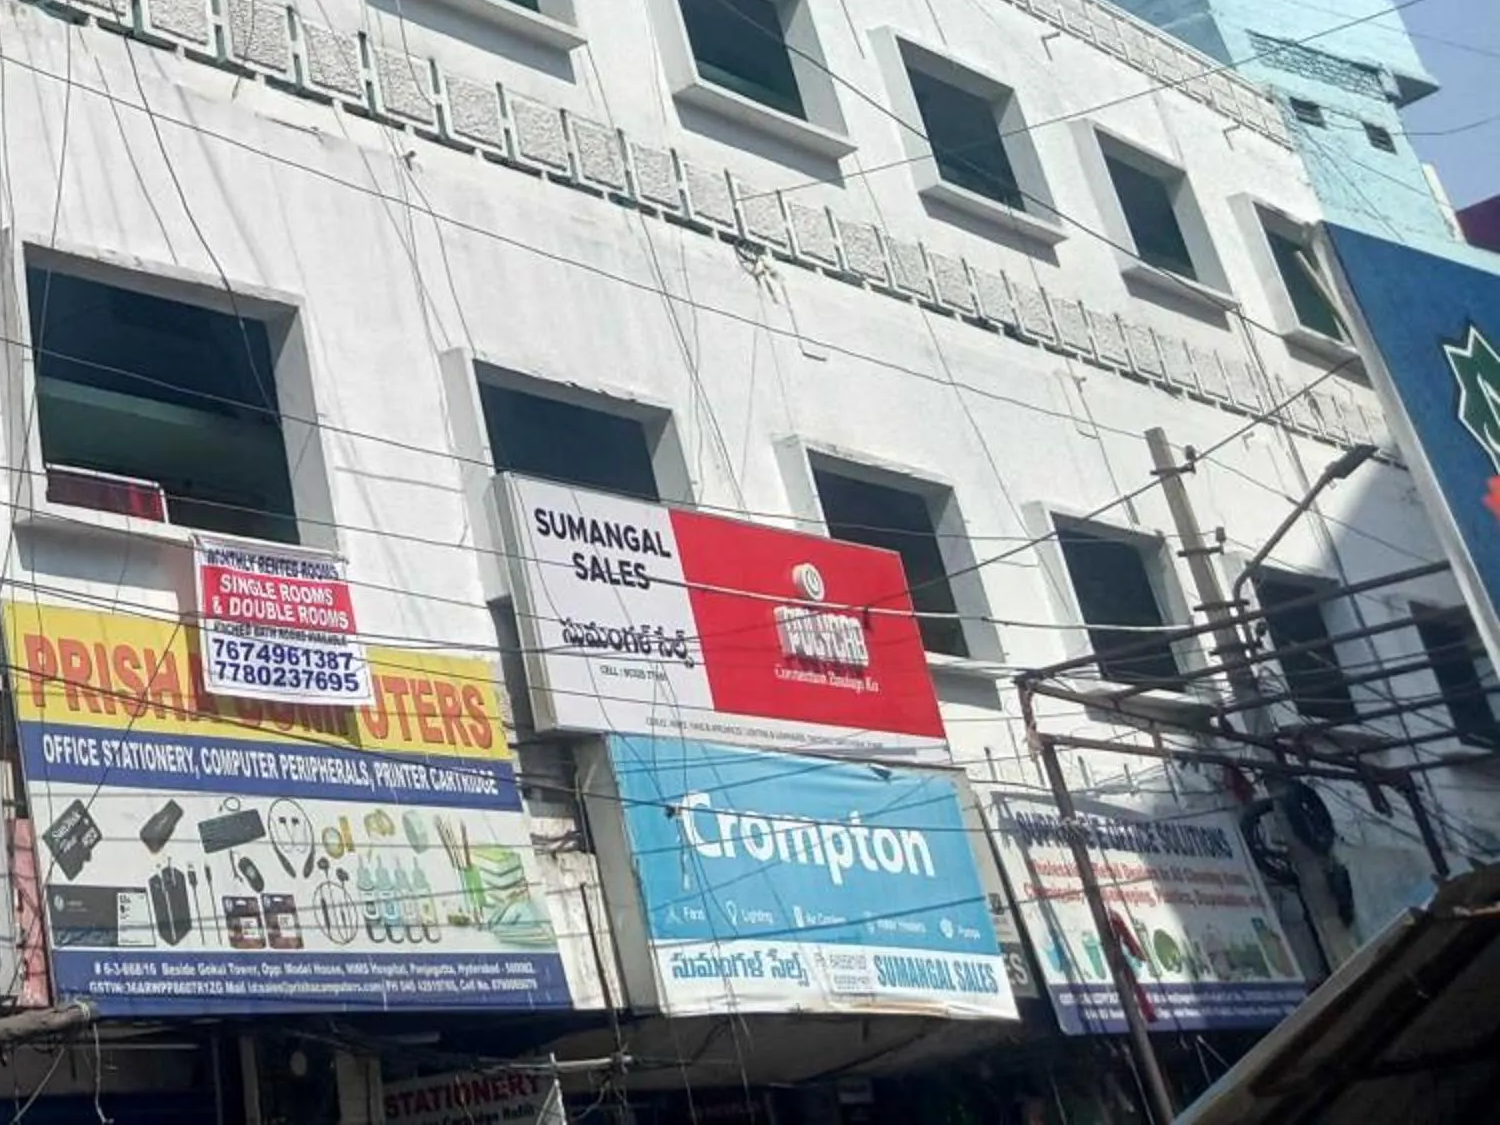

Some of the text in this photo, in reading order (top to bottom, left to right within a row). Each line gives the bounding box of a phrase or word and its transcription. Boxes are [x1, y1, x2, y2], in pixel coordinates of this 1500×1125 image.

[533, 507, 672, 560] SUMANGAL
[219, 574, 334, 606] SINGLE ROOMS
[572, 552, 651, 591] SALES
[212, 595, 349, 630] & DOUBLE ROOMS
[211, 639, 354, 671] 7674961387
[213, 661, 360, 692] 7780237695
[43, 733, 499, 796] OFFICE STATIONERY, COMPUTER PERIPHERALS, PRINTER CARTRIDGE
[679, 792, 935, 885] Crompton
[873, 955, 956, 991] SUMANGAL
[957, 961, 998, 994] SALES
[383, 1073, 541, 1119] STATIONERY
